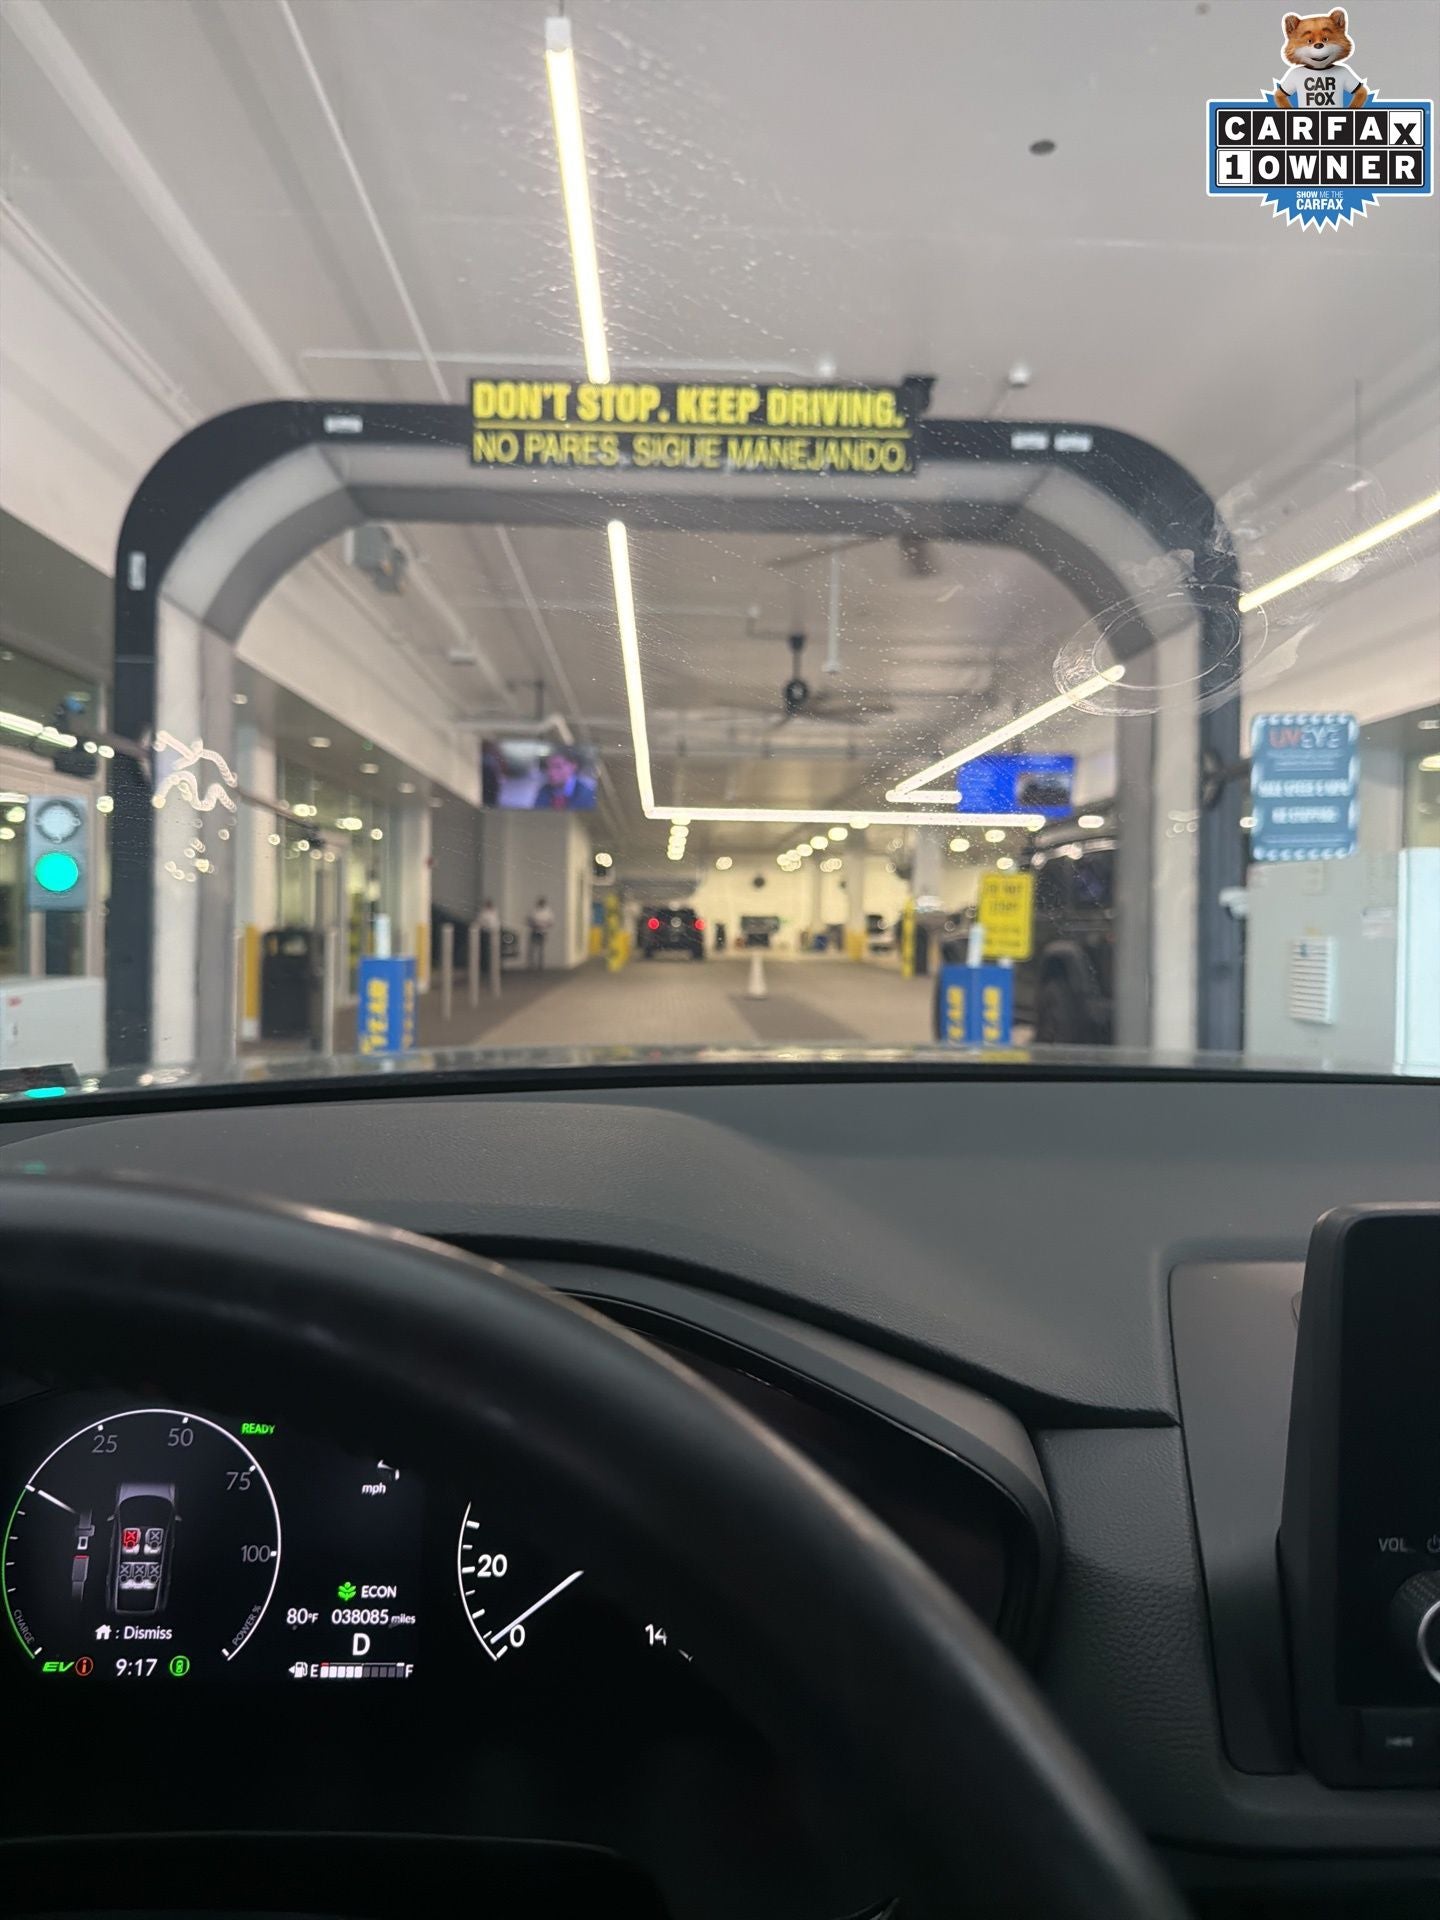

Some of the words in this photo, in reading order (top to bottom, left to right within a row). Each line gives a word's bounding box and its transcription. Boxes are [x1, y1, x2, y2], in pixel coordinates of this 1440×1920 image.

[473, 382, 571, 419] DON'T
[576, 383, 669, 423] STOP.
[676, 386, 760, 424] KEEP
[766, 389, 906, 428] DRIVING.
[473, 430, 518, 463] NO
[632, 434, 722, 468] SIGUE
[727, 437, 912, 473] MANEJANDO.
[167, 1428, 194, 1447] 50
[241, 1422, 275, 1435] READY
[92, 1434, 118, 1453] 25
[225, 1471, 251, 1491] 75
[361, 1482, 387, 1496] mph
[240, 1545, 270, 1563] 100
[1378, 1537, 1408, 1552] VOL
[477, 1554, 508, 1577] 20
[361, 1585, 397, 1599] ECON
[331, 1609, 389, 1625] 038085
[390, 1614, 416, 1625] miles
[13, 1609, 35, 1645] CHARGE
[123, 1626, 173, 1641] Dismiss
[231, 1614, 257, 1646] POWER
[509, 1624, 526, 1648] 0
[352, 1633, 371, 1656] D
[42, 1661, 74, 1673] EV
[115, 1658, 158, 1677] 9:17
[310, 1664, 319, 1677] E
[405, 1664, 414, 1678] F
